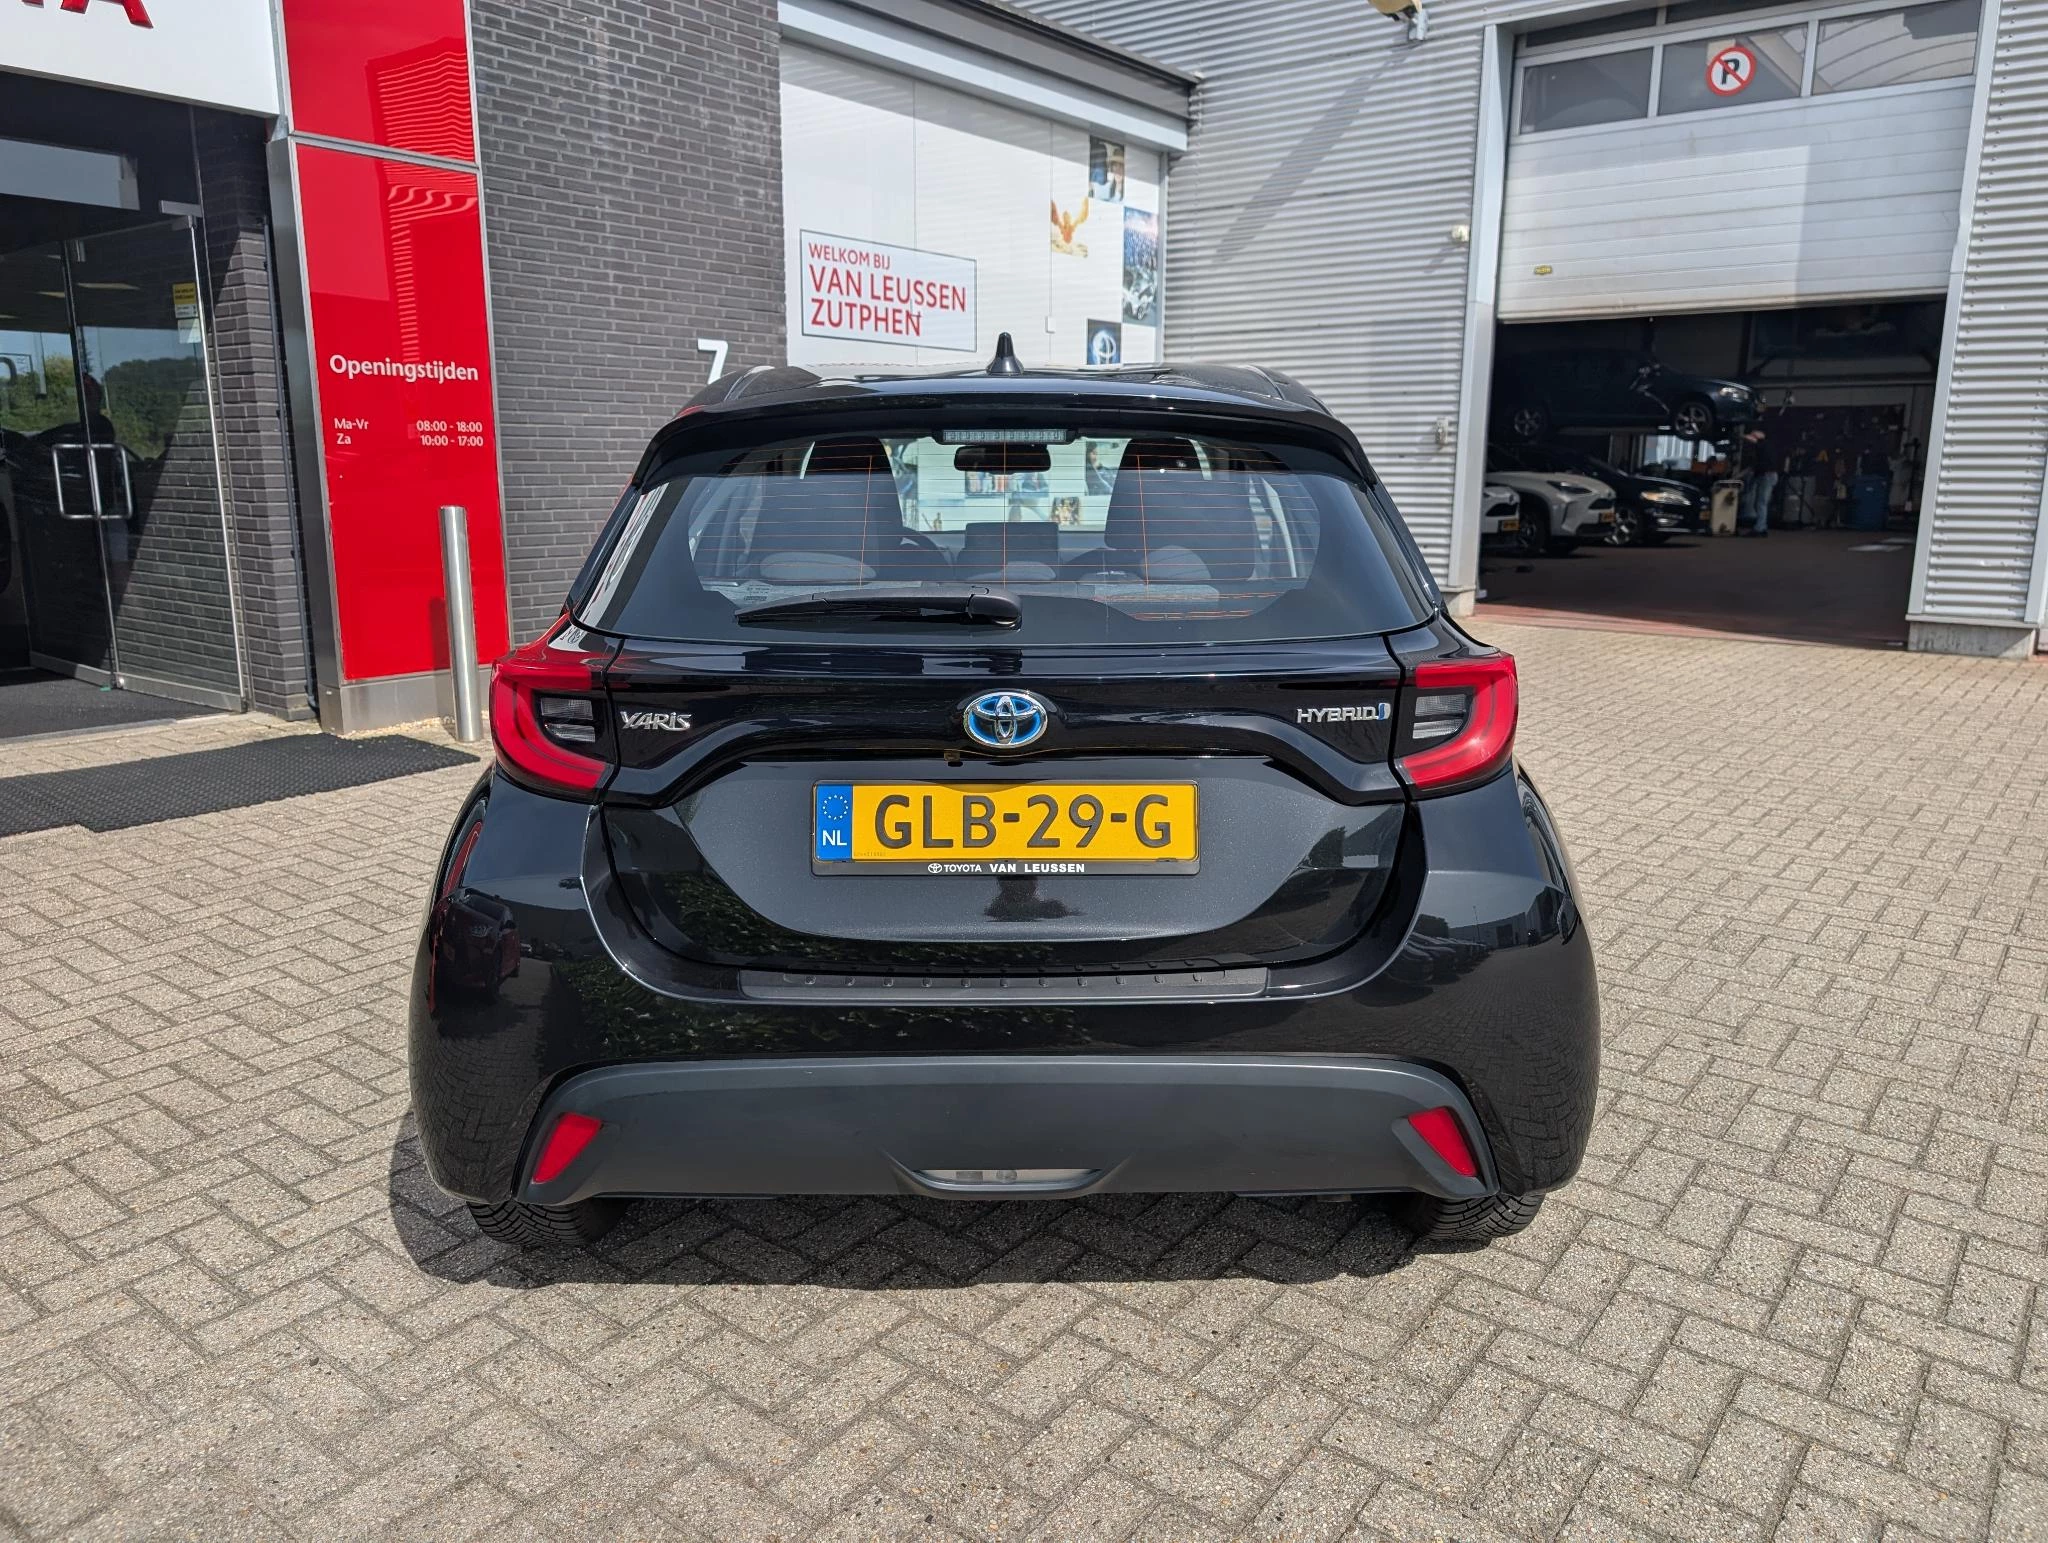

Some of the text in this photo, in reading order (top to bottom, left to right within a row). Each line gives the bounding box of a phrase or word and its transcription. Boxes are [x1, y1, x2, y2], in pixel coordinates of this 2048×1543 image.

[1721, 58, 1740, 85] P
[808, 242, 891, 270] WELKOM BIJ
[808, 263, 966, 312] VAN LEUSSEN
[810, 298, 921, 337] ZUTPHEN
[329, 354, 479, 384] Openingstijden
[697, 338, 728, 385] 7
[333, 417, 369, 430] Ma-Vr
[416, 420, 447, 432] 08:00
[456, 421, 483, 433] 18:00
[336, 433, 351, 445] Za
[420, 435, 449, 446] 10:00
[457, 435, 484, 447] 17:00
[1296, 706, 1378, 723] HYBRID
[874, 794, 1172, 849] GLB-29-G
[822, 830, 848, 846] NL
[943, 863, 1086, 873] TOYOTA VAN LEUSSEN
